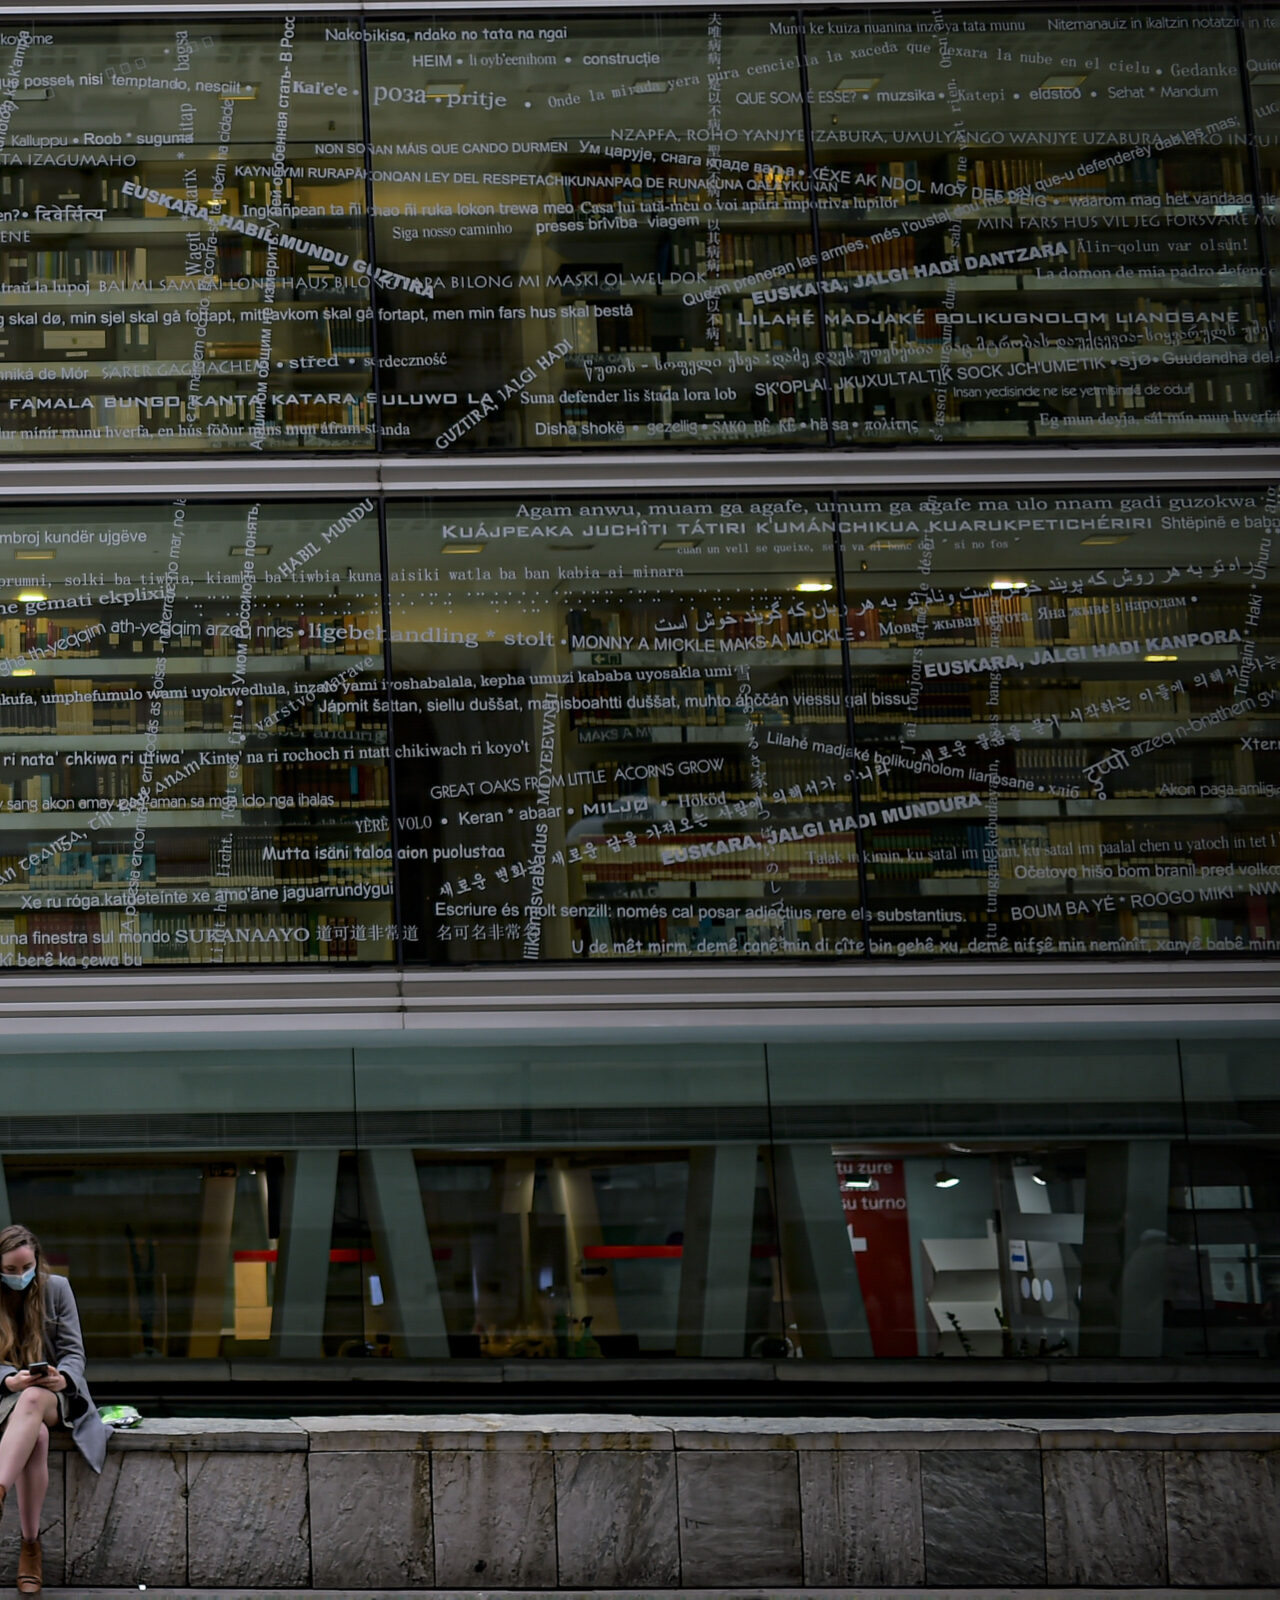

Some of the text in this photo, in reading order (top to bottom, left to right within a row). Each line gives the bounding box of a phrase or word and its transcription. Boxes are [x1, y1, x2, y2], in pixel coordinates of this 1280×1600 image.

[413, 55, 452, 67] HEIM
[79, 72, 103, 86] nisi
[374, 86, 429, 105] роза
[447, 91, 506, 110] pritje
[83, 132, 122, 145] Roob
[431, 142, 568, 154] QUE CANDO DURMEN
[752, 242, 1067, 304] EUSKARA, JALGI DANTZARA
[42, 312, 65, 325] dø,
[70, 312, 96, 324] min
[101, 311, 127, 327] sjel
[1116, 312, 1238, 323] LIANOSANE
[10, 398, 94, 409] FAMALA
[1169, 497, 1256, 511] guzokwa
[322, 498, 376, 542] MUNDU
[0, 531, 39, 547] mbroj
[443, 524, 573, 538] KUÁJPEAKA
[572, 634, 633, 651] MONNY
[924, 629, 1243, 677] EUSKARA, JALGI HADI KANPORA
[486, 740, 529, 757] koyo't
[66, 752, 117, 766] chkiwa
[882, 794, 981, 822] MUNDURA
[459, 811, 503, 825] Keran
[32, 923, 310, 945] finestra SUKANAAYO
